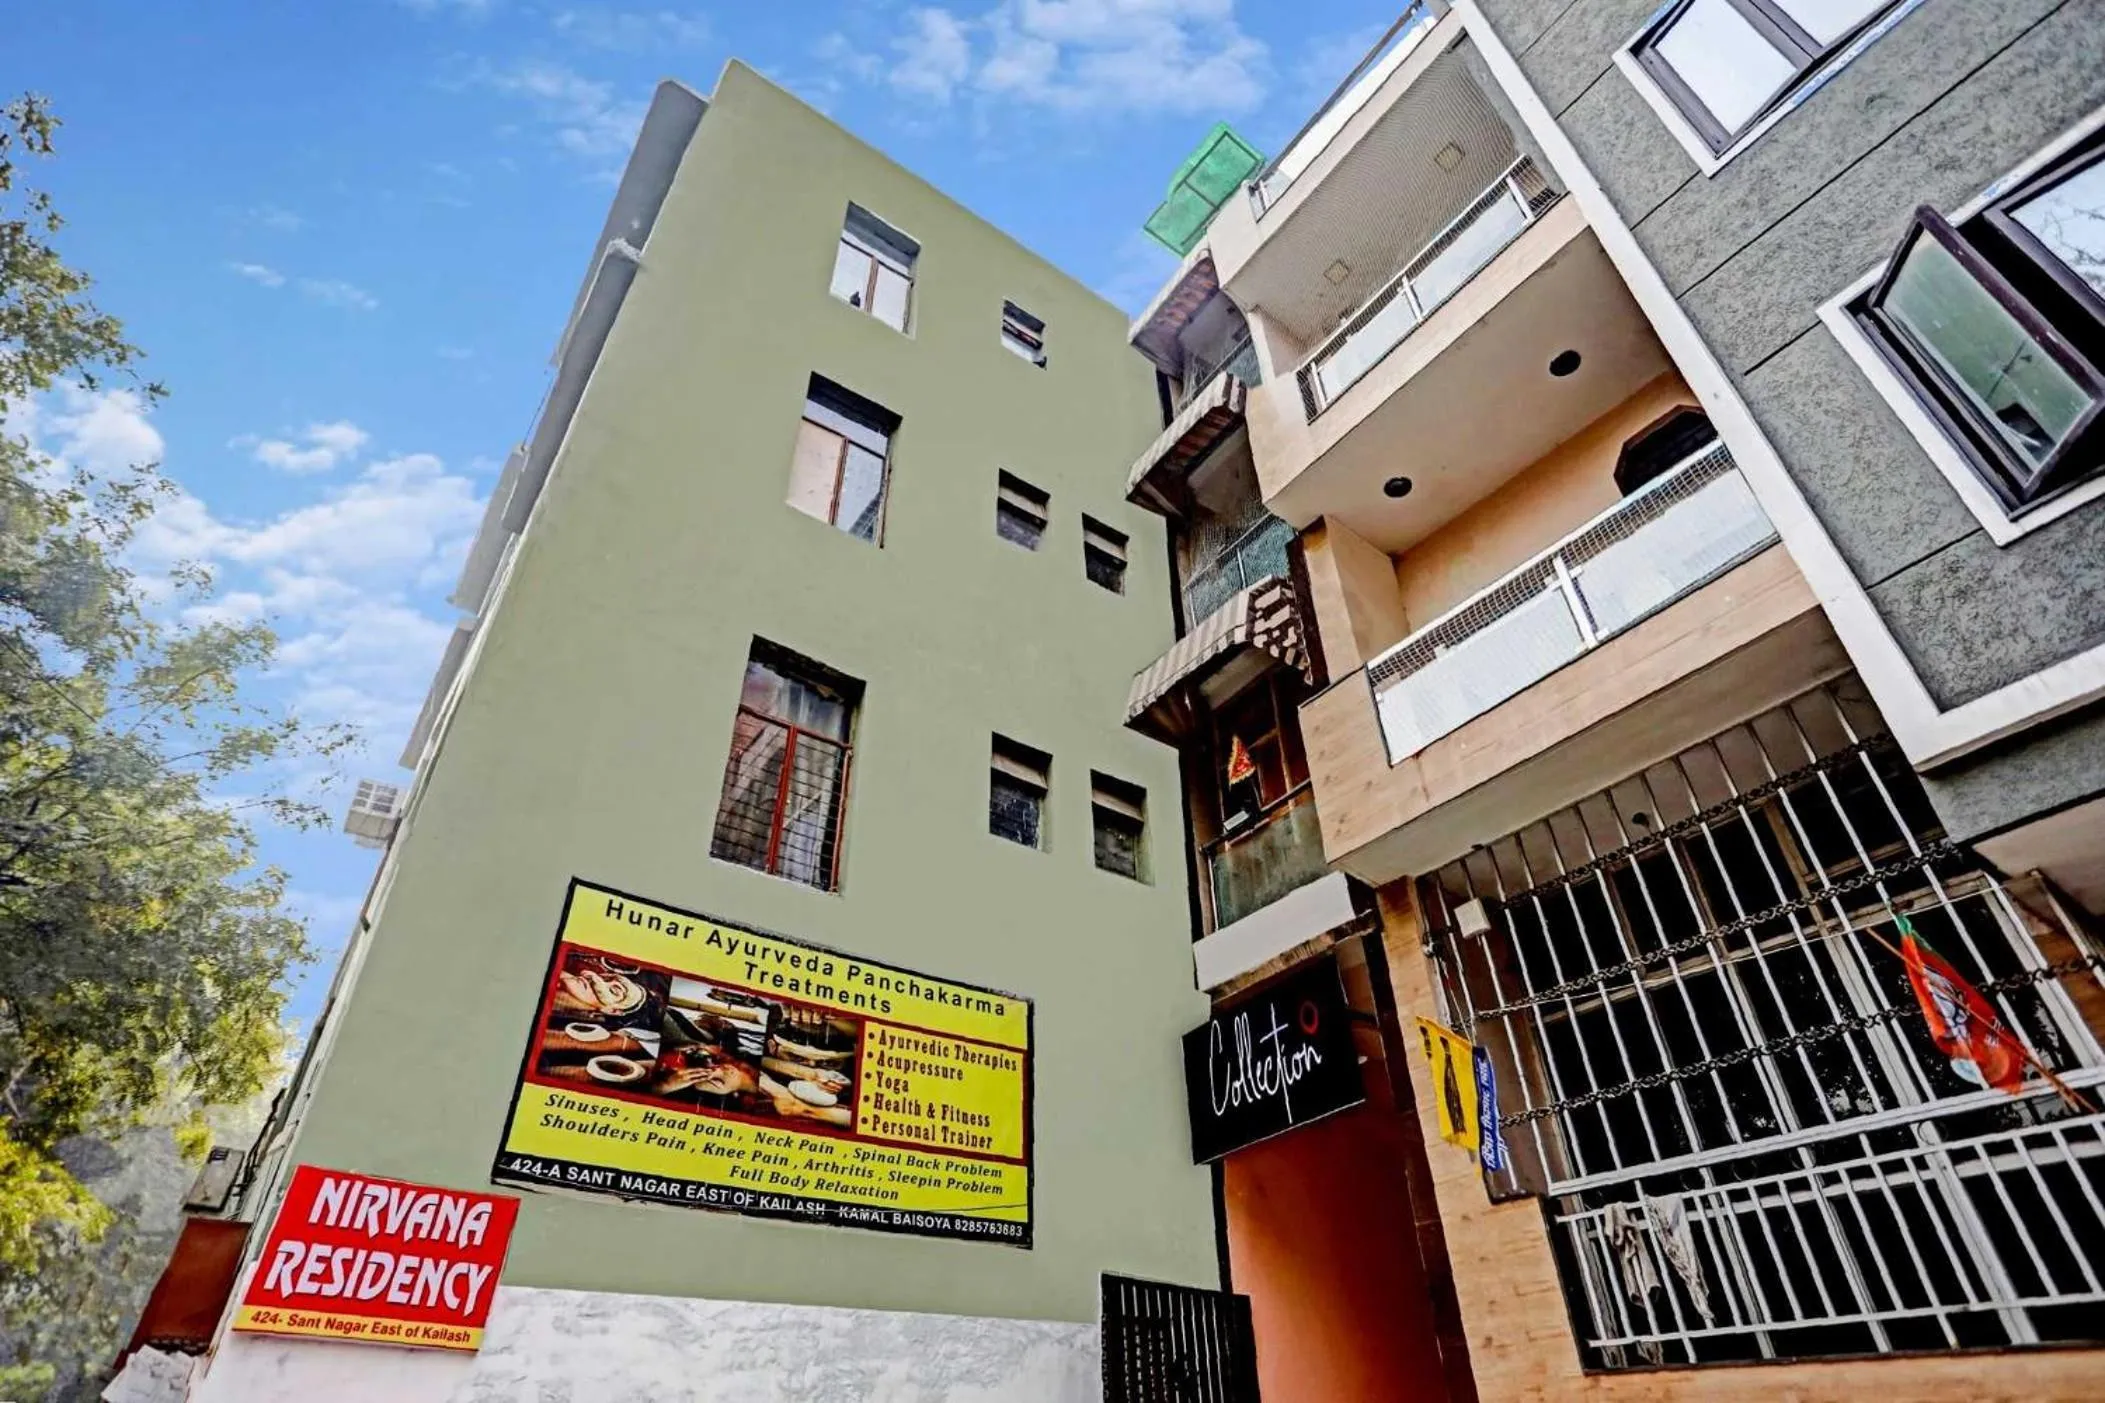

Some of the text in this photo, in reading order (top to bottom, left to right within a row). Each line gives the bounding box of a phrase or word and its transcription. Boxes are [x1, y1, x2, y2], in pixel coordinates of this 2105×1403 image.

[606, 899, 1005, 1016] Hunar Ayurveda Panchakarma
[744, 961, 891, 1013] Treatments
[877, 1050, 964, 1081] Acupressure
[879, 1030, 1017, 1072] Ayurvedic Therapies
[1209, 1002, 1322, 1124] Collection
[876, 1071, 909, 1094] Yoga
[872, 1114, 993, 1149] Personal Trainer
[874, 1092, 990, 1127] Health & Fitness
[540, 1113, 640, 1142] Shoulders
[645, 1131, 687, 1150] Pain
[702, 1141, 746, 1160] Knee
[751, 1149, 789, 1166] Pain
[803, 1158, 874, 1178] Arthritis
[888, 1170, 941, 1189] Sleepin
[946, 1177, 1003, 1195] Problem
[642, 1111, 690, 1131] Head
[754, 1131, 792, 1148] Neck
[798, 1135, 834, 1155] Pain
[853, 1147, 901, 1166] Spinal
[906, 1156, 940, 1170] Back
[945, 1161, 1002, 1178] Problem
[510, 1158, 561, 1178] 424-A
[567, 1165, 616, 1187] SANT
[620, 1177, 680, 1198] NAGAR
[685, 1184, 728, 1203] EAST
[733, 1191, 754, 1207] OF
[839, 1205, 889, 1223] KAMAL
[893, 1212, 950, 1230] BAISOYA
[729, 1165, 899, 1200] Full Body Relaxation
[309, 1177, 492, 1249] NIRVANA
[264, 1239, 493, 1316] RESIDENCY
[251, 1311, 471, 1343] 424- Sant Nagar East of Kailash
